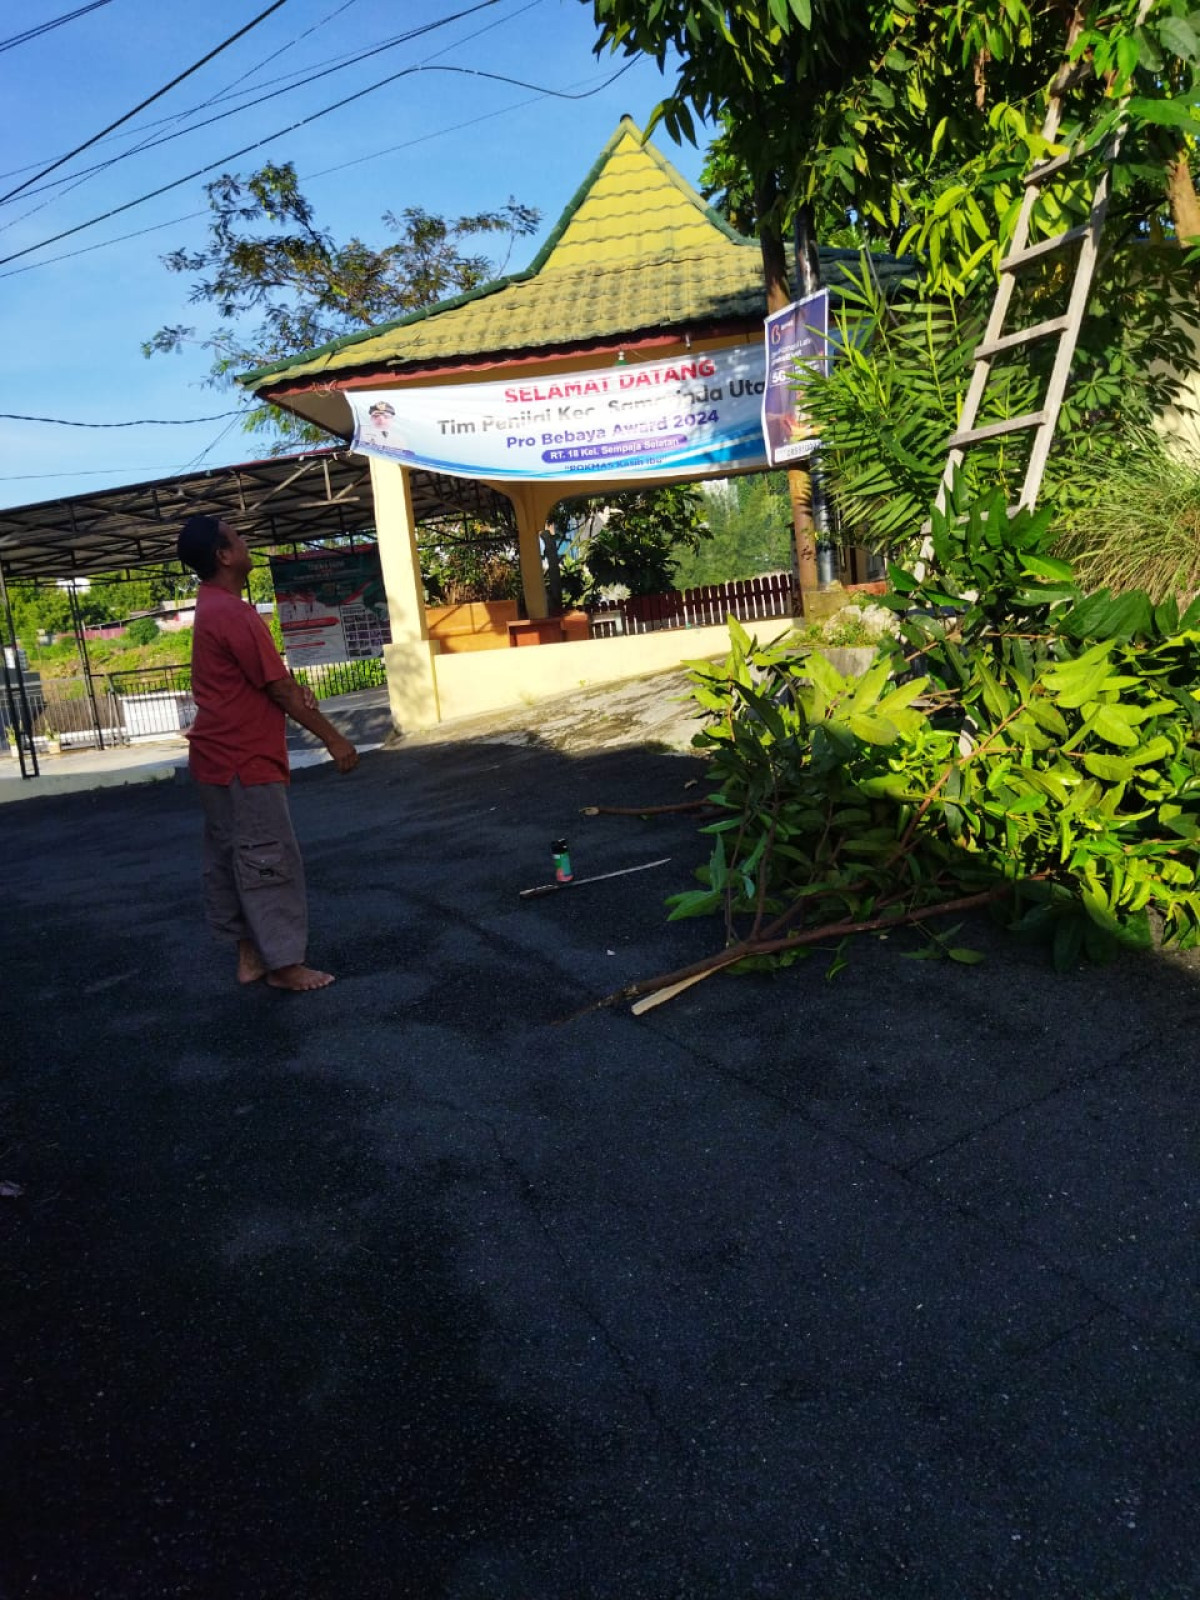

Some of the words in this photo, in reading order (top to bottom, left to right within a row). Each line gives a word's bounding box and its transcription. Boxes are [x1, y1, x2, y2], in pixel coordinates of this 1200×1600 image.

[504, 377, 611, 403] SELAMAT
[619, 359, 716, 390] DATANG
[437, 419, 475, 435] Tim
[608, 384, 723, 413] Samnda
[729, 379, 766, 398] Uta
[506, 436, 536, 449] Pro
[541, 427, 606, 446] Bebaya
[613, 416, 668, 437] Award
[673, 409, 720, 429] 2024
[550, 450, 566, 460] RT.
